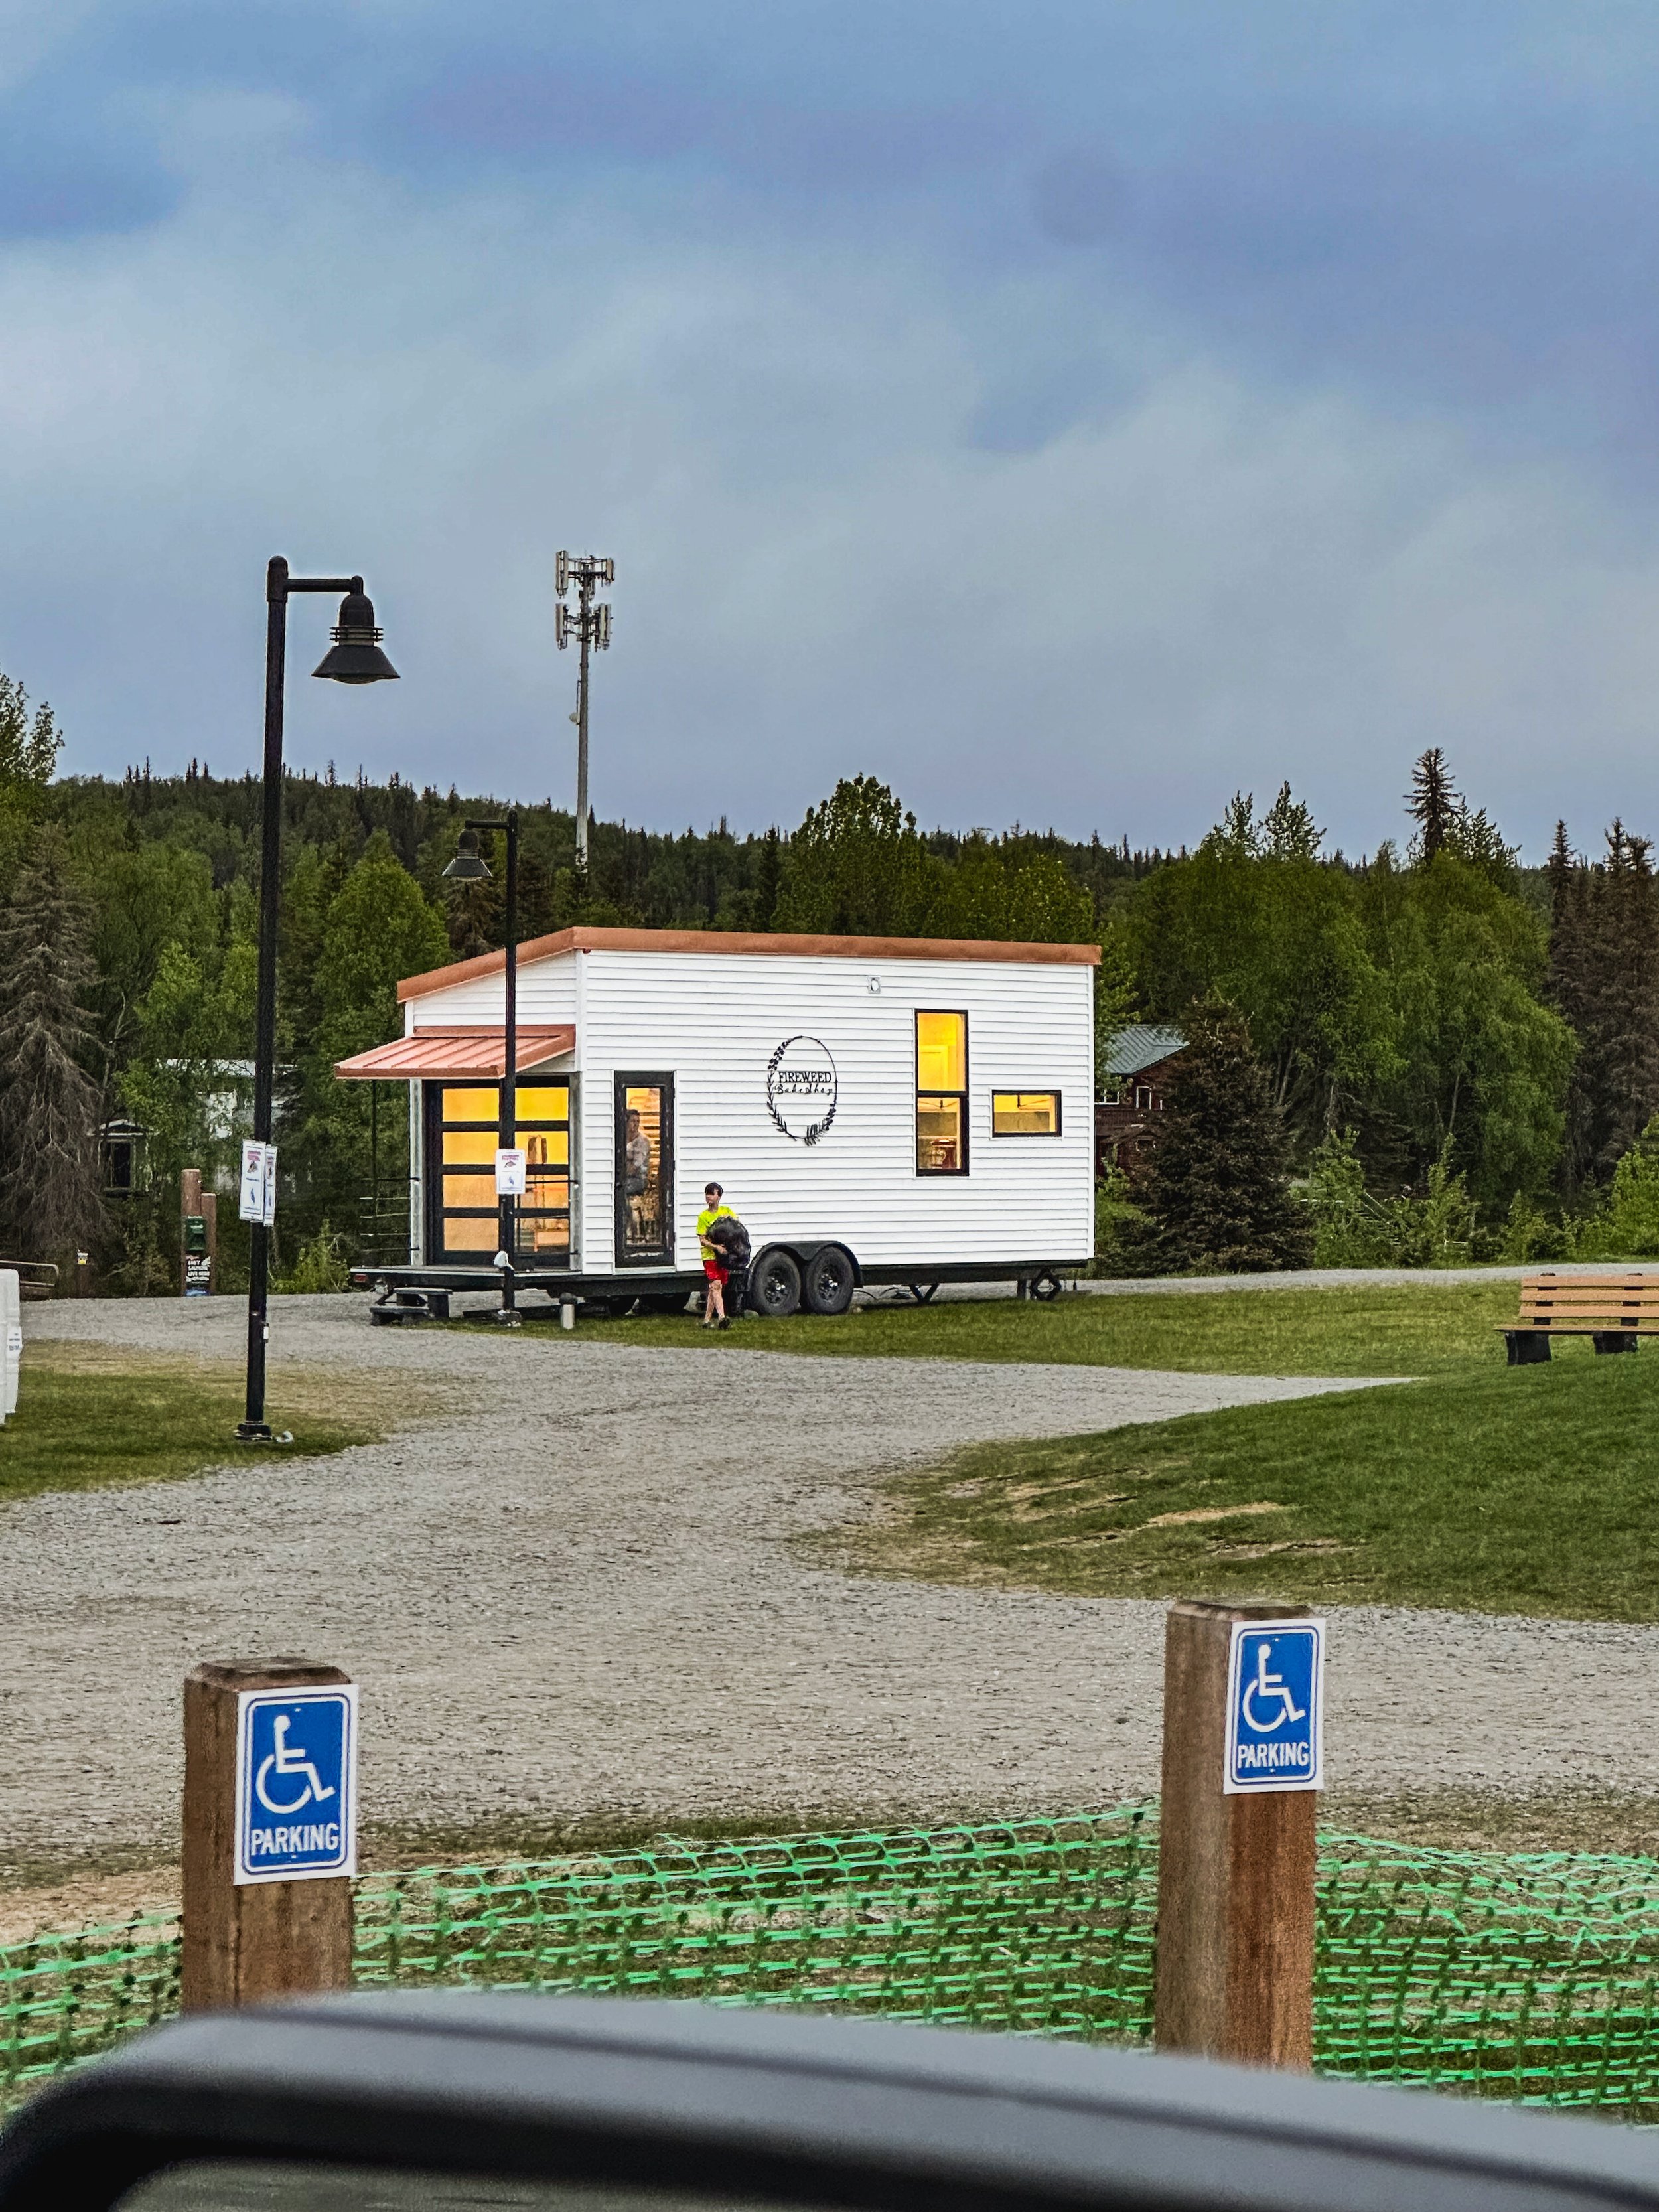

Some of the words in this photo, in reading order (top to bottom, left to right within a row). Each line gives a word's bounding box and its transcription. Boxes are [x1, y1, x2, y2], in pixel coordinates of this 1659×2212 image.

[778, 1071, 831, 1083] FIREWEED
[1237, 1742, 1309, 1769] PARKING
[250, 1822, 340, 1856] PARKING
